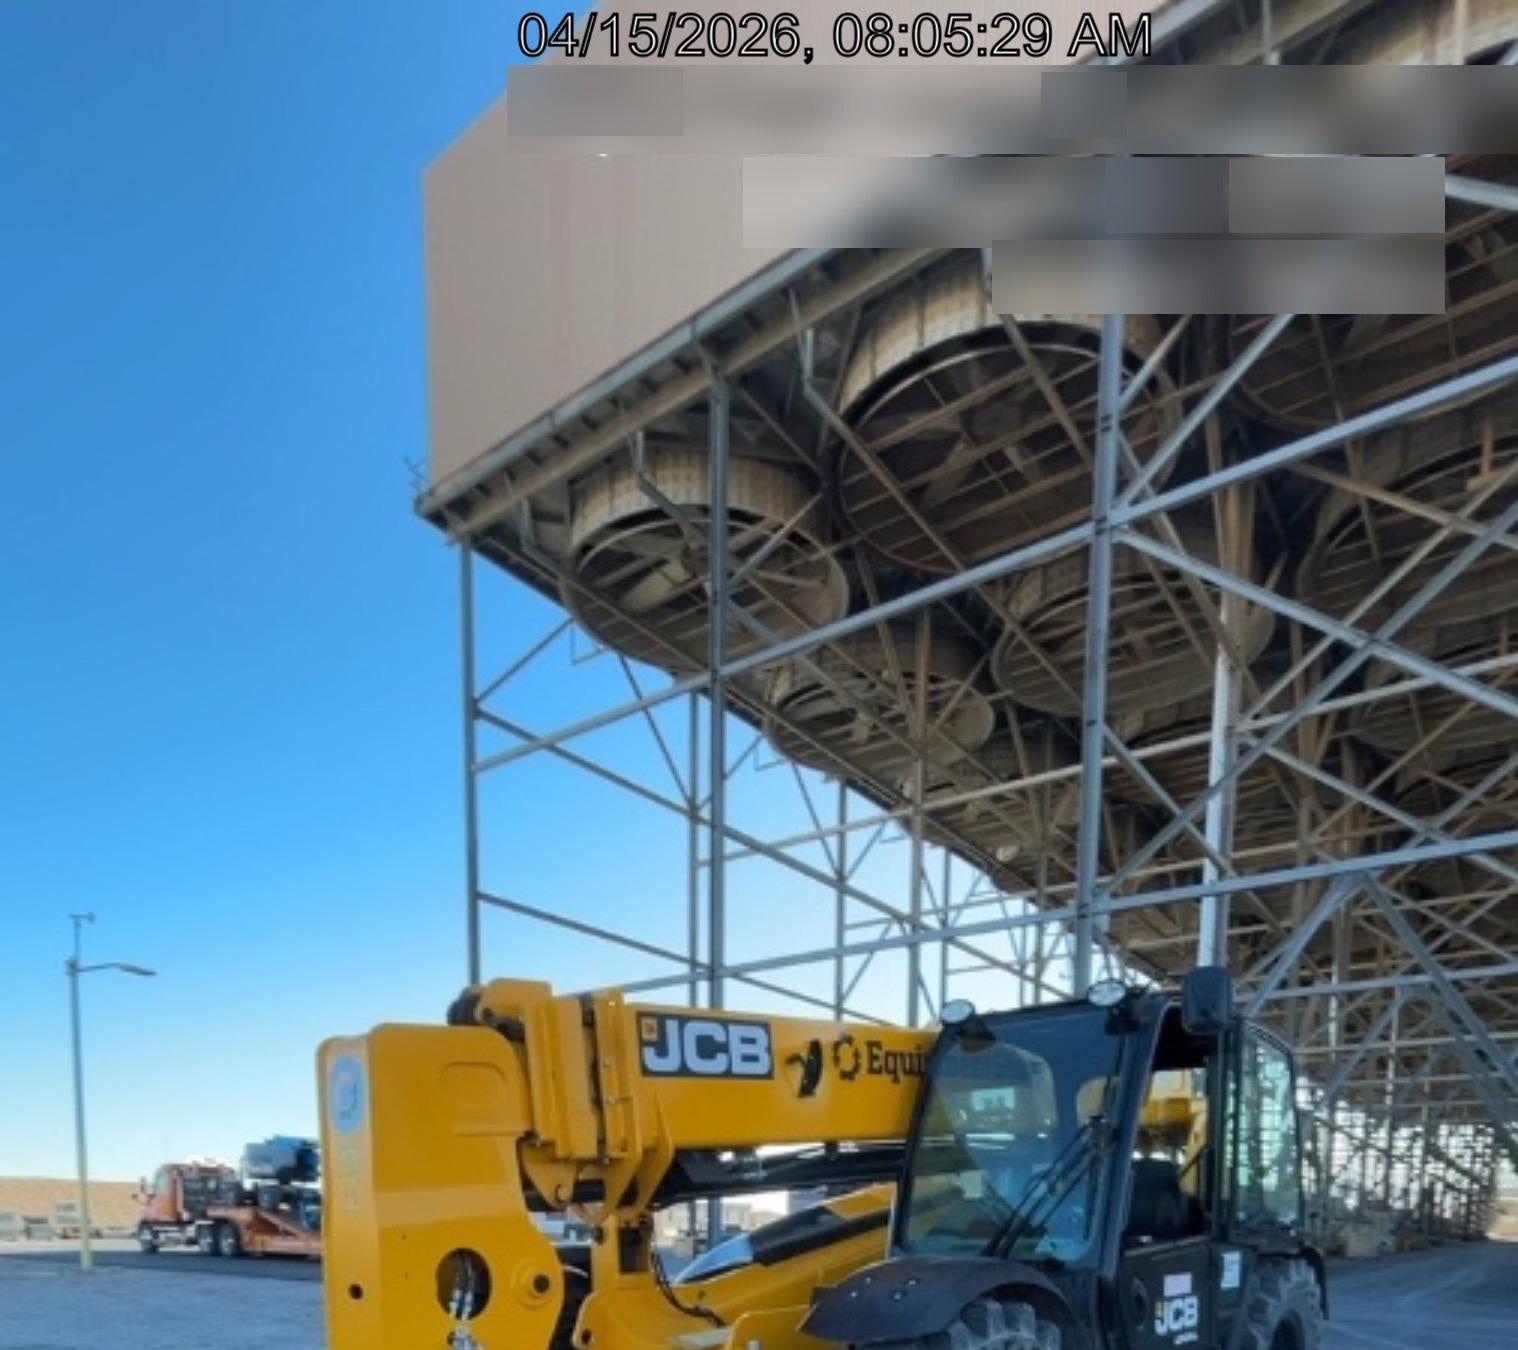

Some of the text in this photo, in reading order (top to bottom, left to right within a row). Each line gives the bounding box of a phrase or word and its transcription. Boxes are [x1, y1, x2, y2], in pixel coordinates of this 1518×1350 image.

[642, 1018, 770, 1076] JCB
[865, 1039, 927, 1083] Equi
[1155, 1296, 1199, 1336] JCB
